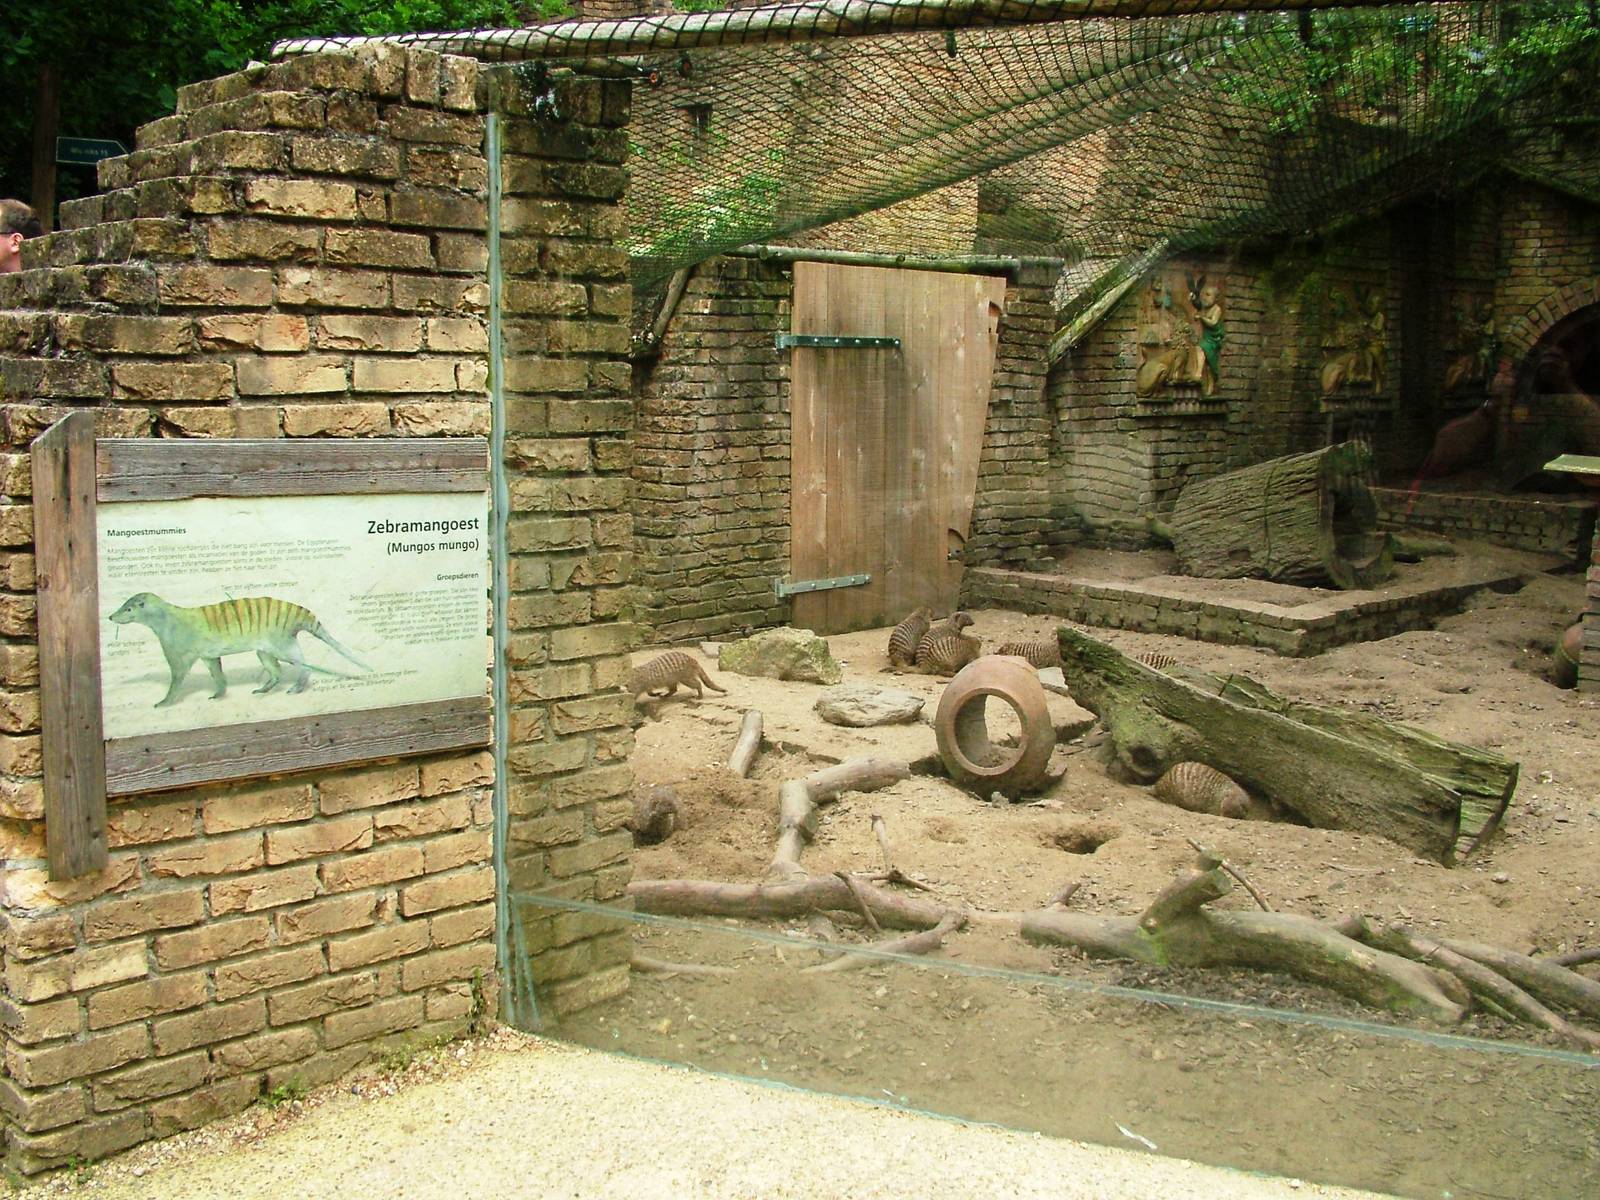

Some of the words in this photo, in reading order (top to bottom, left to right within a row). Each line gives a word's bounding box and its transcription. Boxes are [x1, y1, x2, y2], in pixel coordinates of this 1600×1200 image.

[107, 527, 187, 538] Mangoestmummies
[367, 518, 479, 534] Zebramangoest
[387, 542, 436, 555] (Mungos
[438, 538, 479, 552] mungo)
[437, 571, 479, 581] Groepsdieren
